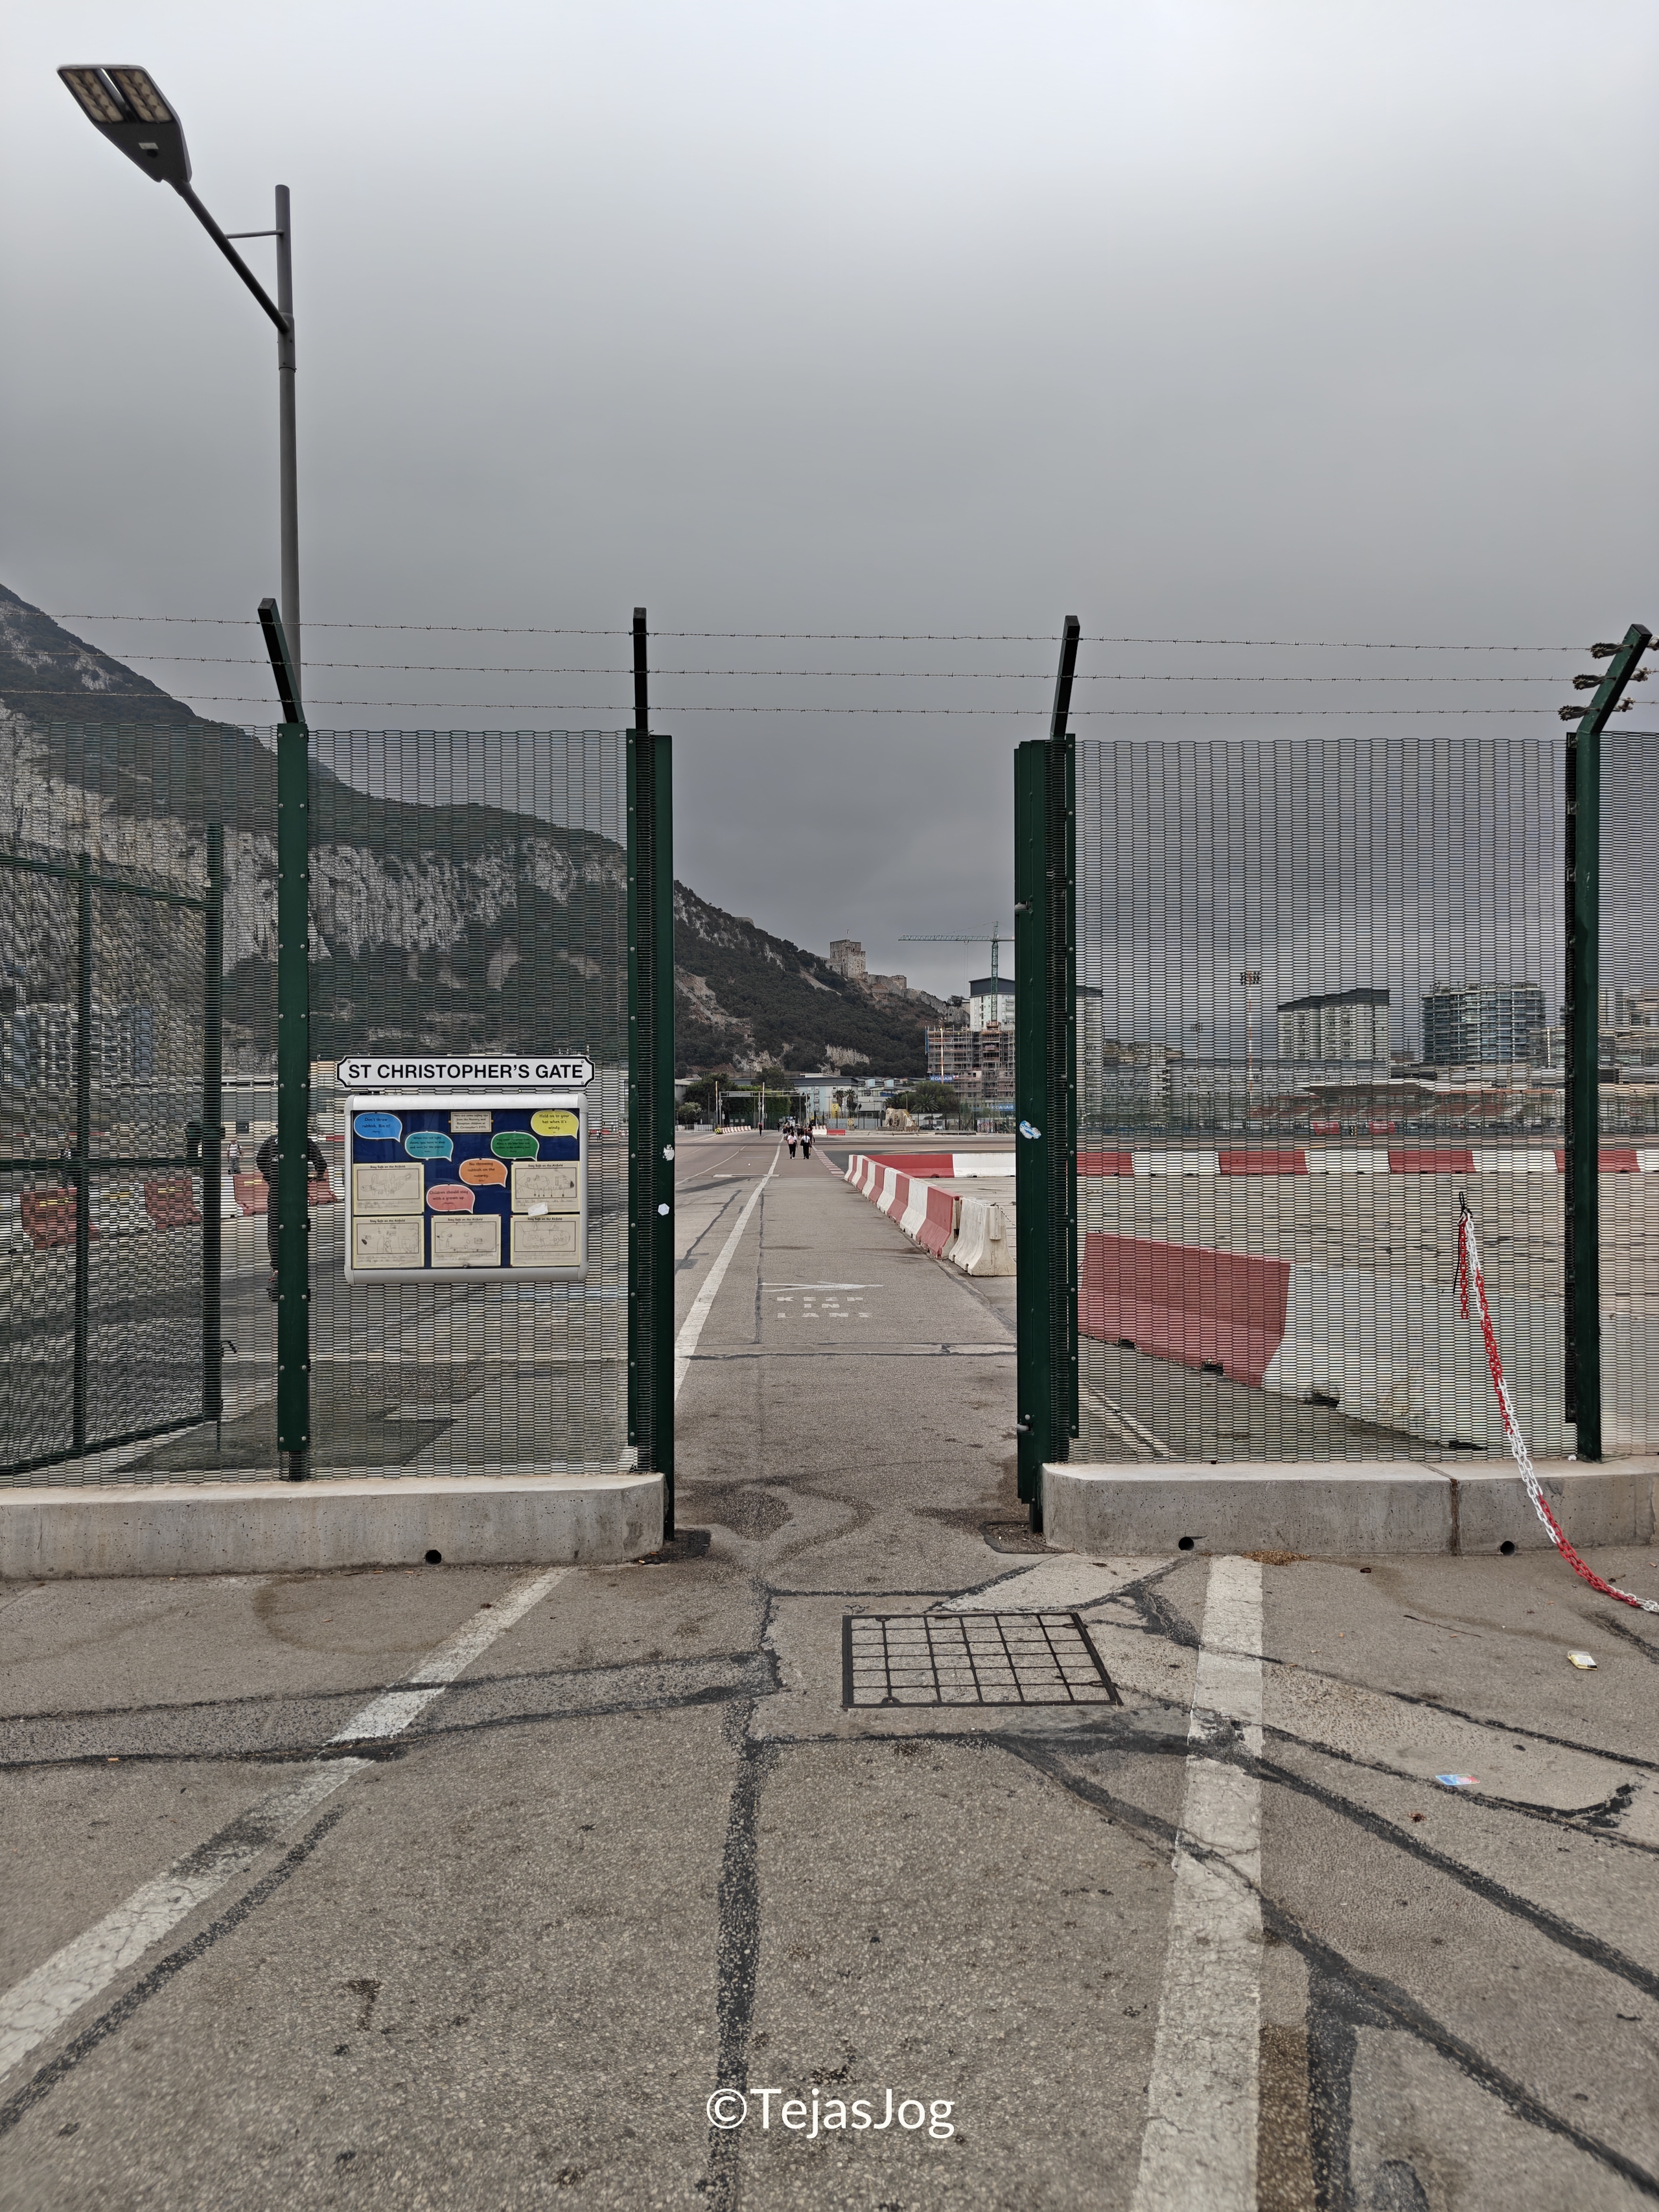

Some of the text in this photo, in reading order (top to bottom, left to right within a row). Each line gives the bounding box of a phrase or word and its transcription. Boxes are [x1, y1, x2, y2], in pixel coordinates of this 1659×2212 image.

[348, 1064, 583, 1078] ST CHRISTOPHER'S GATE
